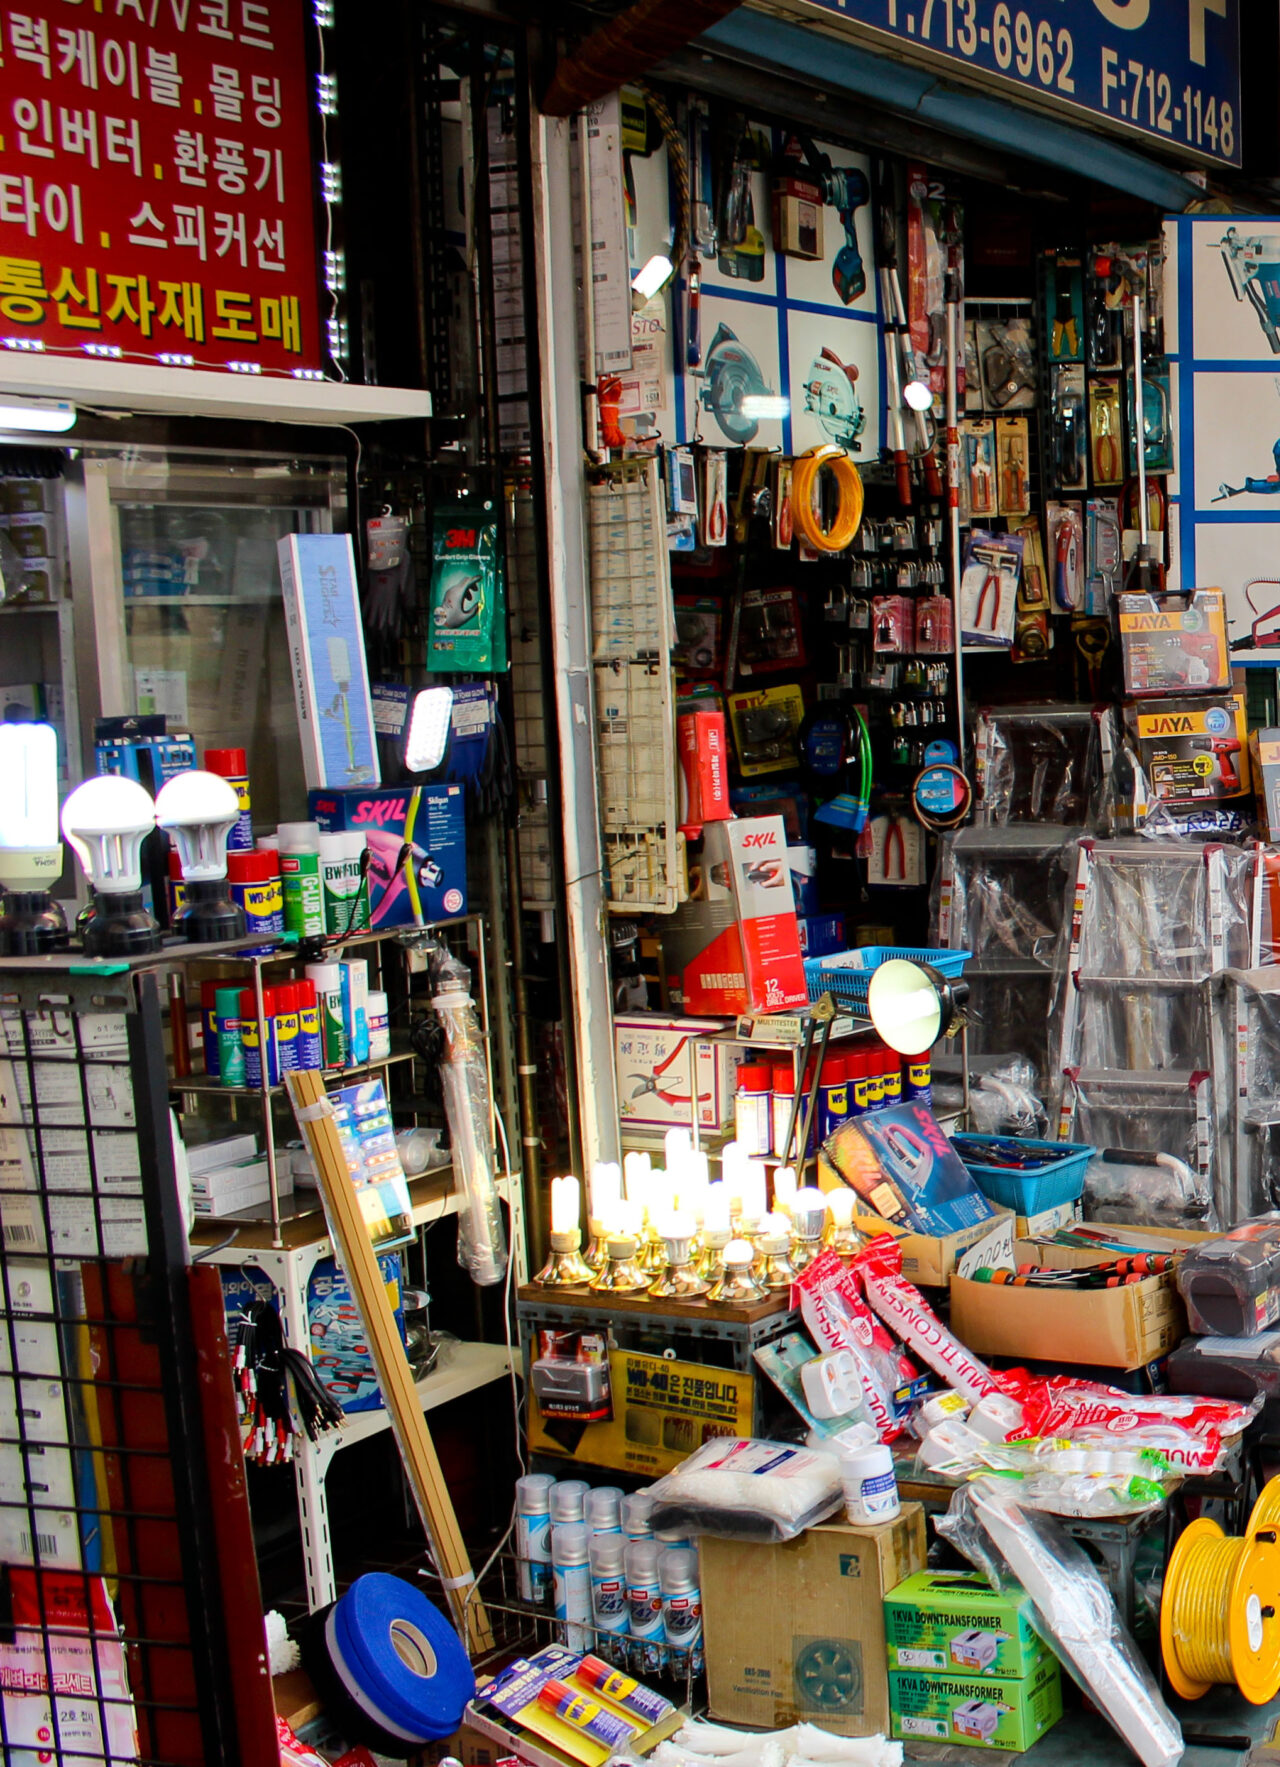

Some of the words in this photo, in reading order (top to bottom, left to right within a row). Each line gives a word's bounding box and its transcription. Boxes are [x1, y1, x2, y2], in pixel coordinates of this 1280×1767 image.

[1101, 46, 1235, 158] F:712-1148
[128, 201, 286, 273] 스피커선
[445, 529, 476, 549] 3M
[1127, 616, 1172, 630] JAYA
[1146, 717, 1195, 734] JAYA
[352, 799, 406, 827] SKIL
[742, 831, 777, 849] SKIL
[764, 979, 779, 994] 12
[757, 1018, 798, 1028] MULTITESTER
[912, 1106, 952, 1158] SKIL
[938, 1344, 992, 1398] MULTI
[892, 1609, 914, 1623] 1KVA
[914, 1612, 1002, 1629] DOWNTRANSFORMER
[897, 1677, 917, 1691] 1KVA
[920, 1680, 1004, 1701] DOWNTRANSFORMER
